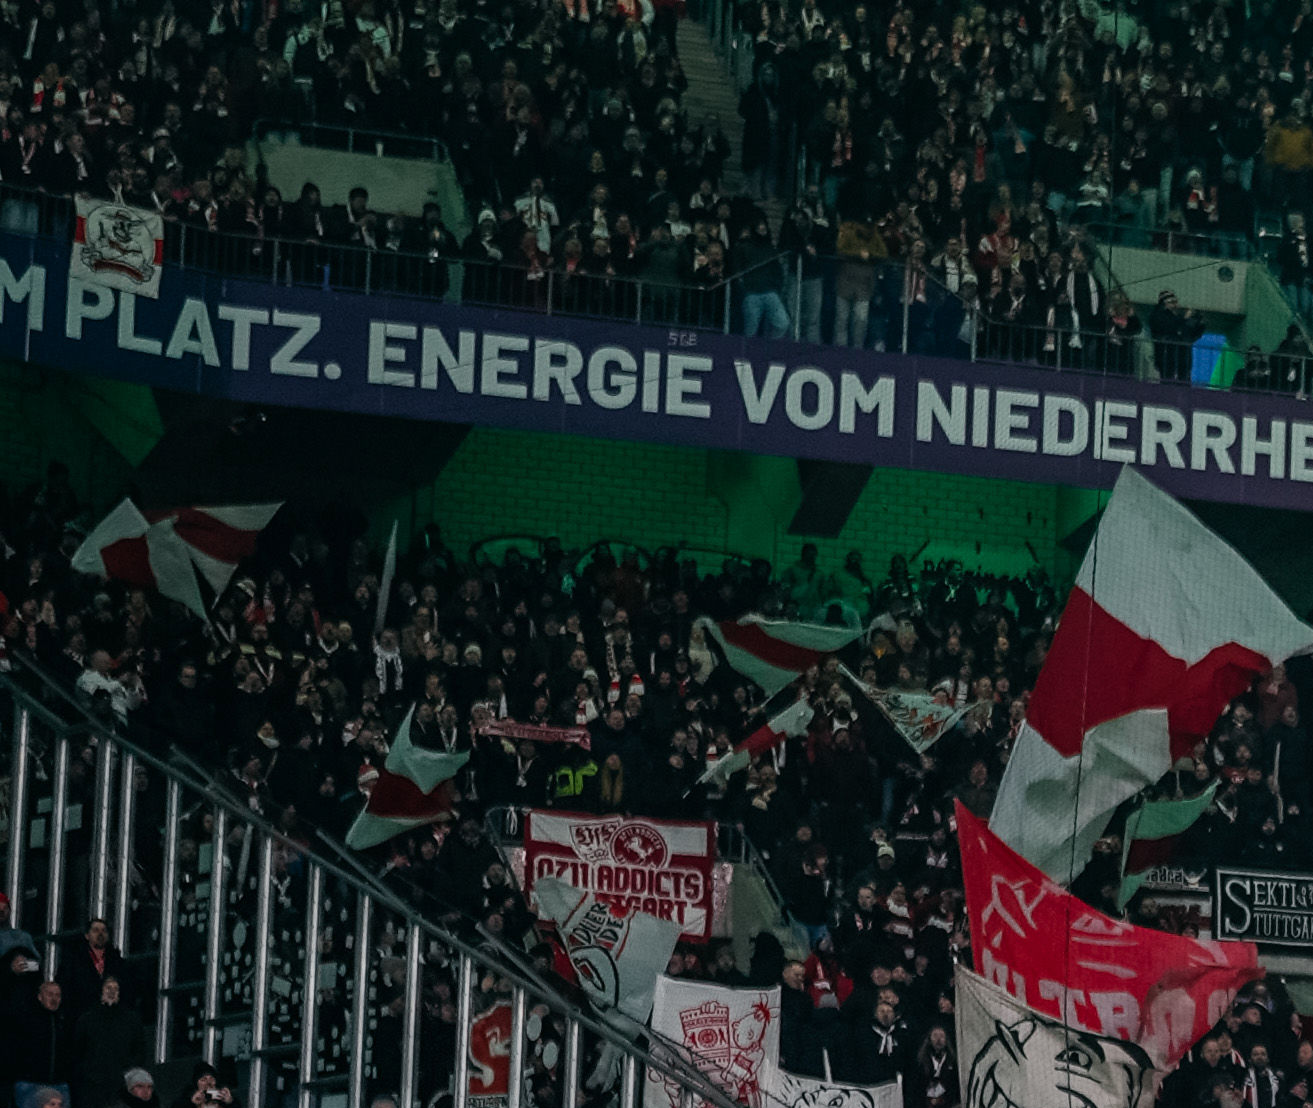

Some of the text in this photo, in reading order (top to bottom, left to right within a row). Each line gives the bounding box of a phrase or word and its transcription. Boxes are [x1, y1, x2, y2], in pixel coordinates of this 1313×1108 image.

[65, 280, 342, 381] PLATZ.
[367, 321, 714, 420] ENERGIE
[735, 360, 896, 439] VOM
[598, 864, 702, 901] ADDICTS
